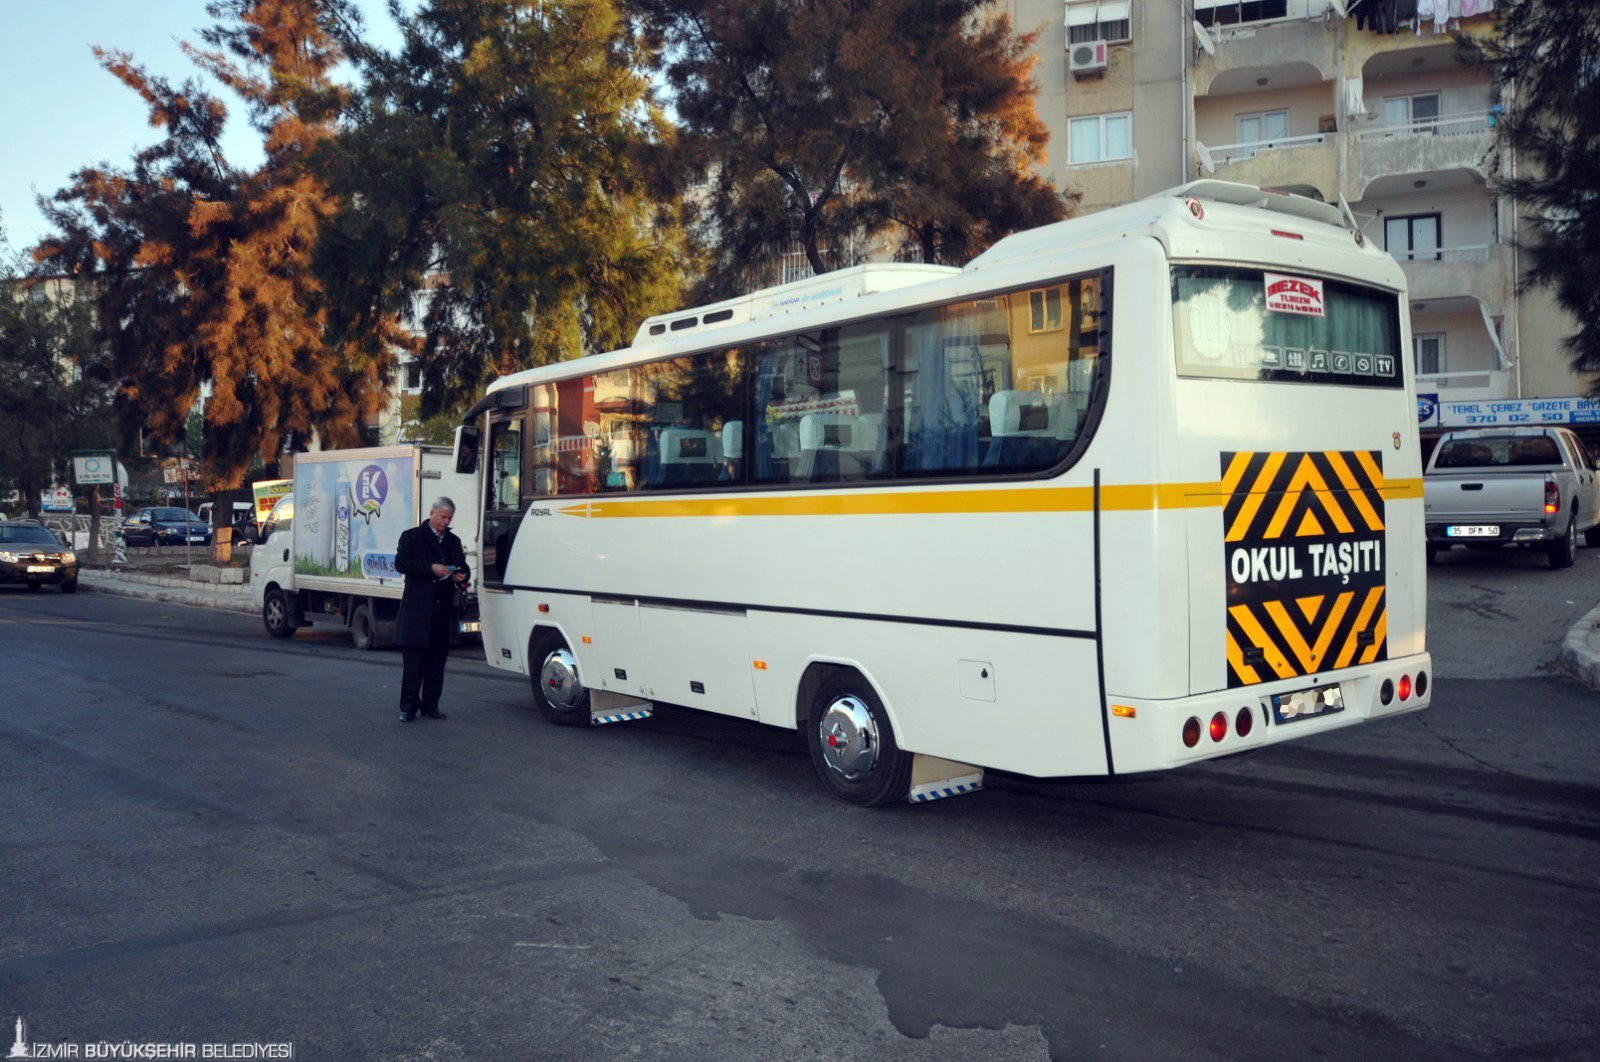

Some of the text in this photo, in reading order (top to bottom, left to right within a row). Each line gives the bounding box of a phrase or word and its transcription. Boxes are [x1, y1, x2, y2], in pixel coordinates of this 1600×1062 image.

[1378, 360, 1391, 372] TV
[1467, 414, 1497, 424] 370
[1508, 414, 1530, 423] 02
[1542, 413, 1564, 422] 50
[531, 508, 552, 516] ROYAL
[1453, 527, 1462, 535] 35
[1231, 540, 1381, 584] OKUL TAŞITI
